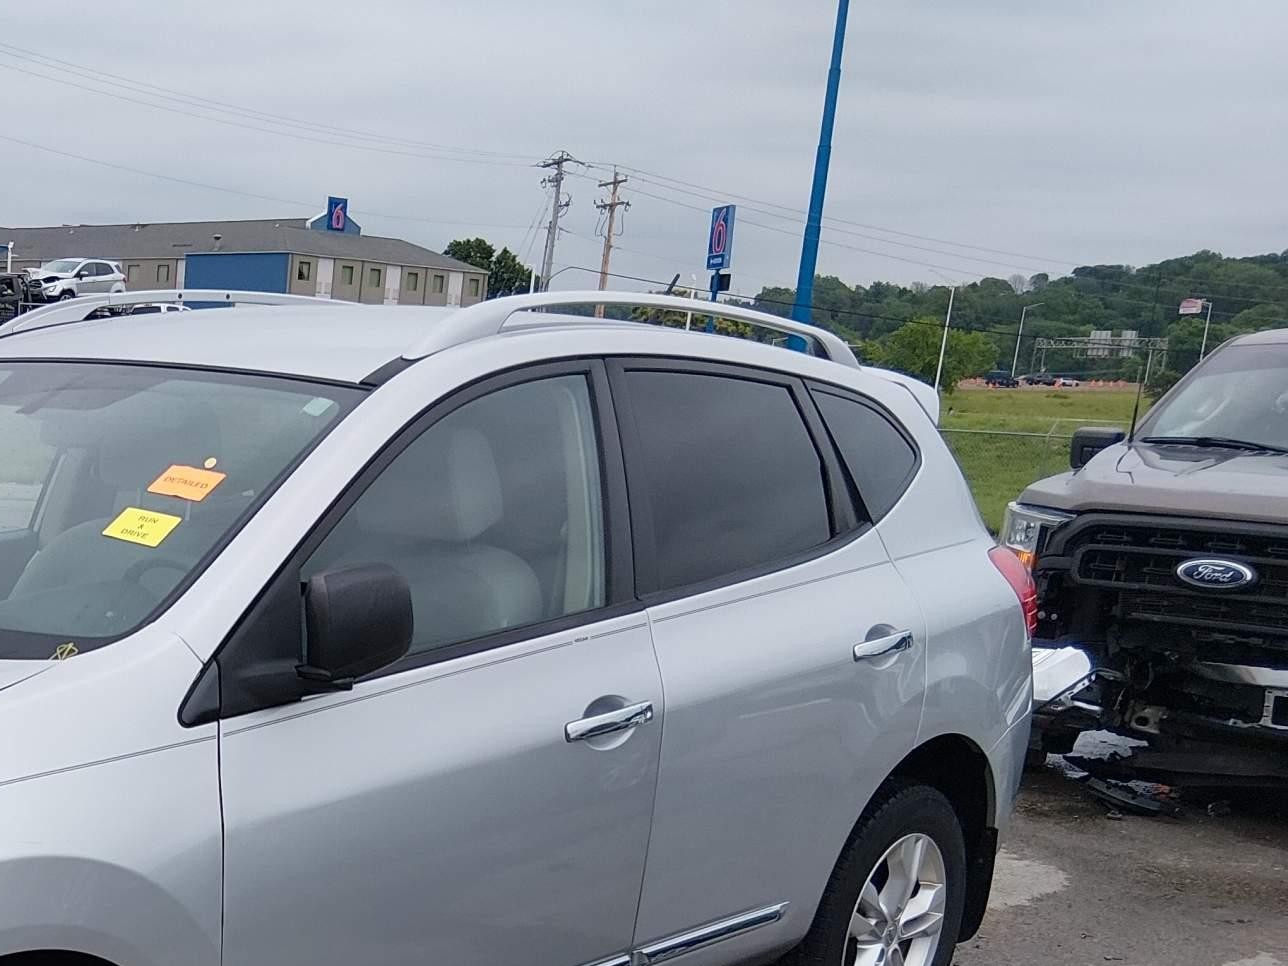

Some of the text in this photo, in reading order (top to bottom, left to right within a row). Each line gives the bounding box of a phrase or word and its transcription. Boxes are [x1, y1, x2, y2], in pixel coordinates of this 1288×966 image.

[332, 203, 344, 229] 6
[712, 208, 727, 255] 6
[163, 475, 209, 489] DETAILED
[138, 515, 159, 524] RUN
[120, 528, 148, 539] DRIVE
[1193, 564, 1235, 583] Ford
